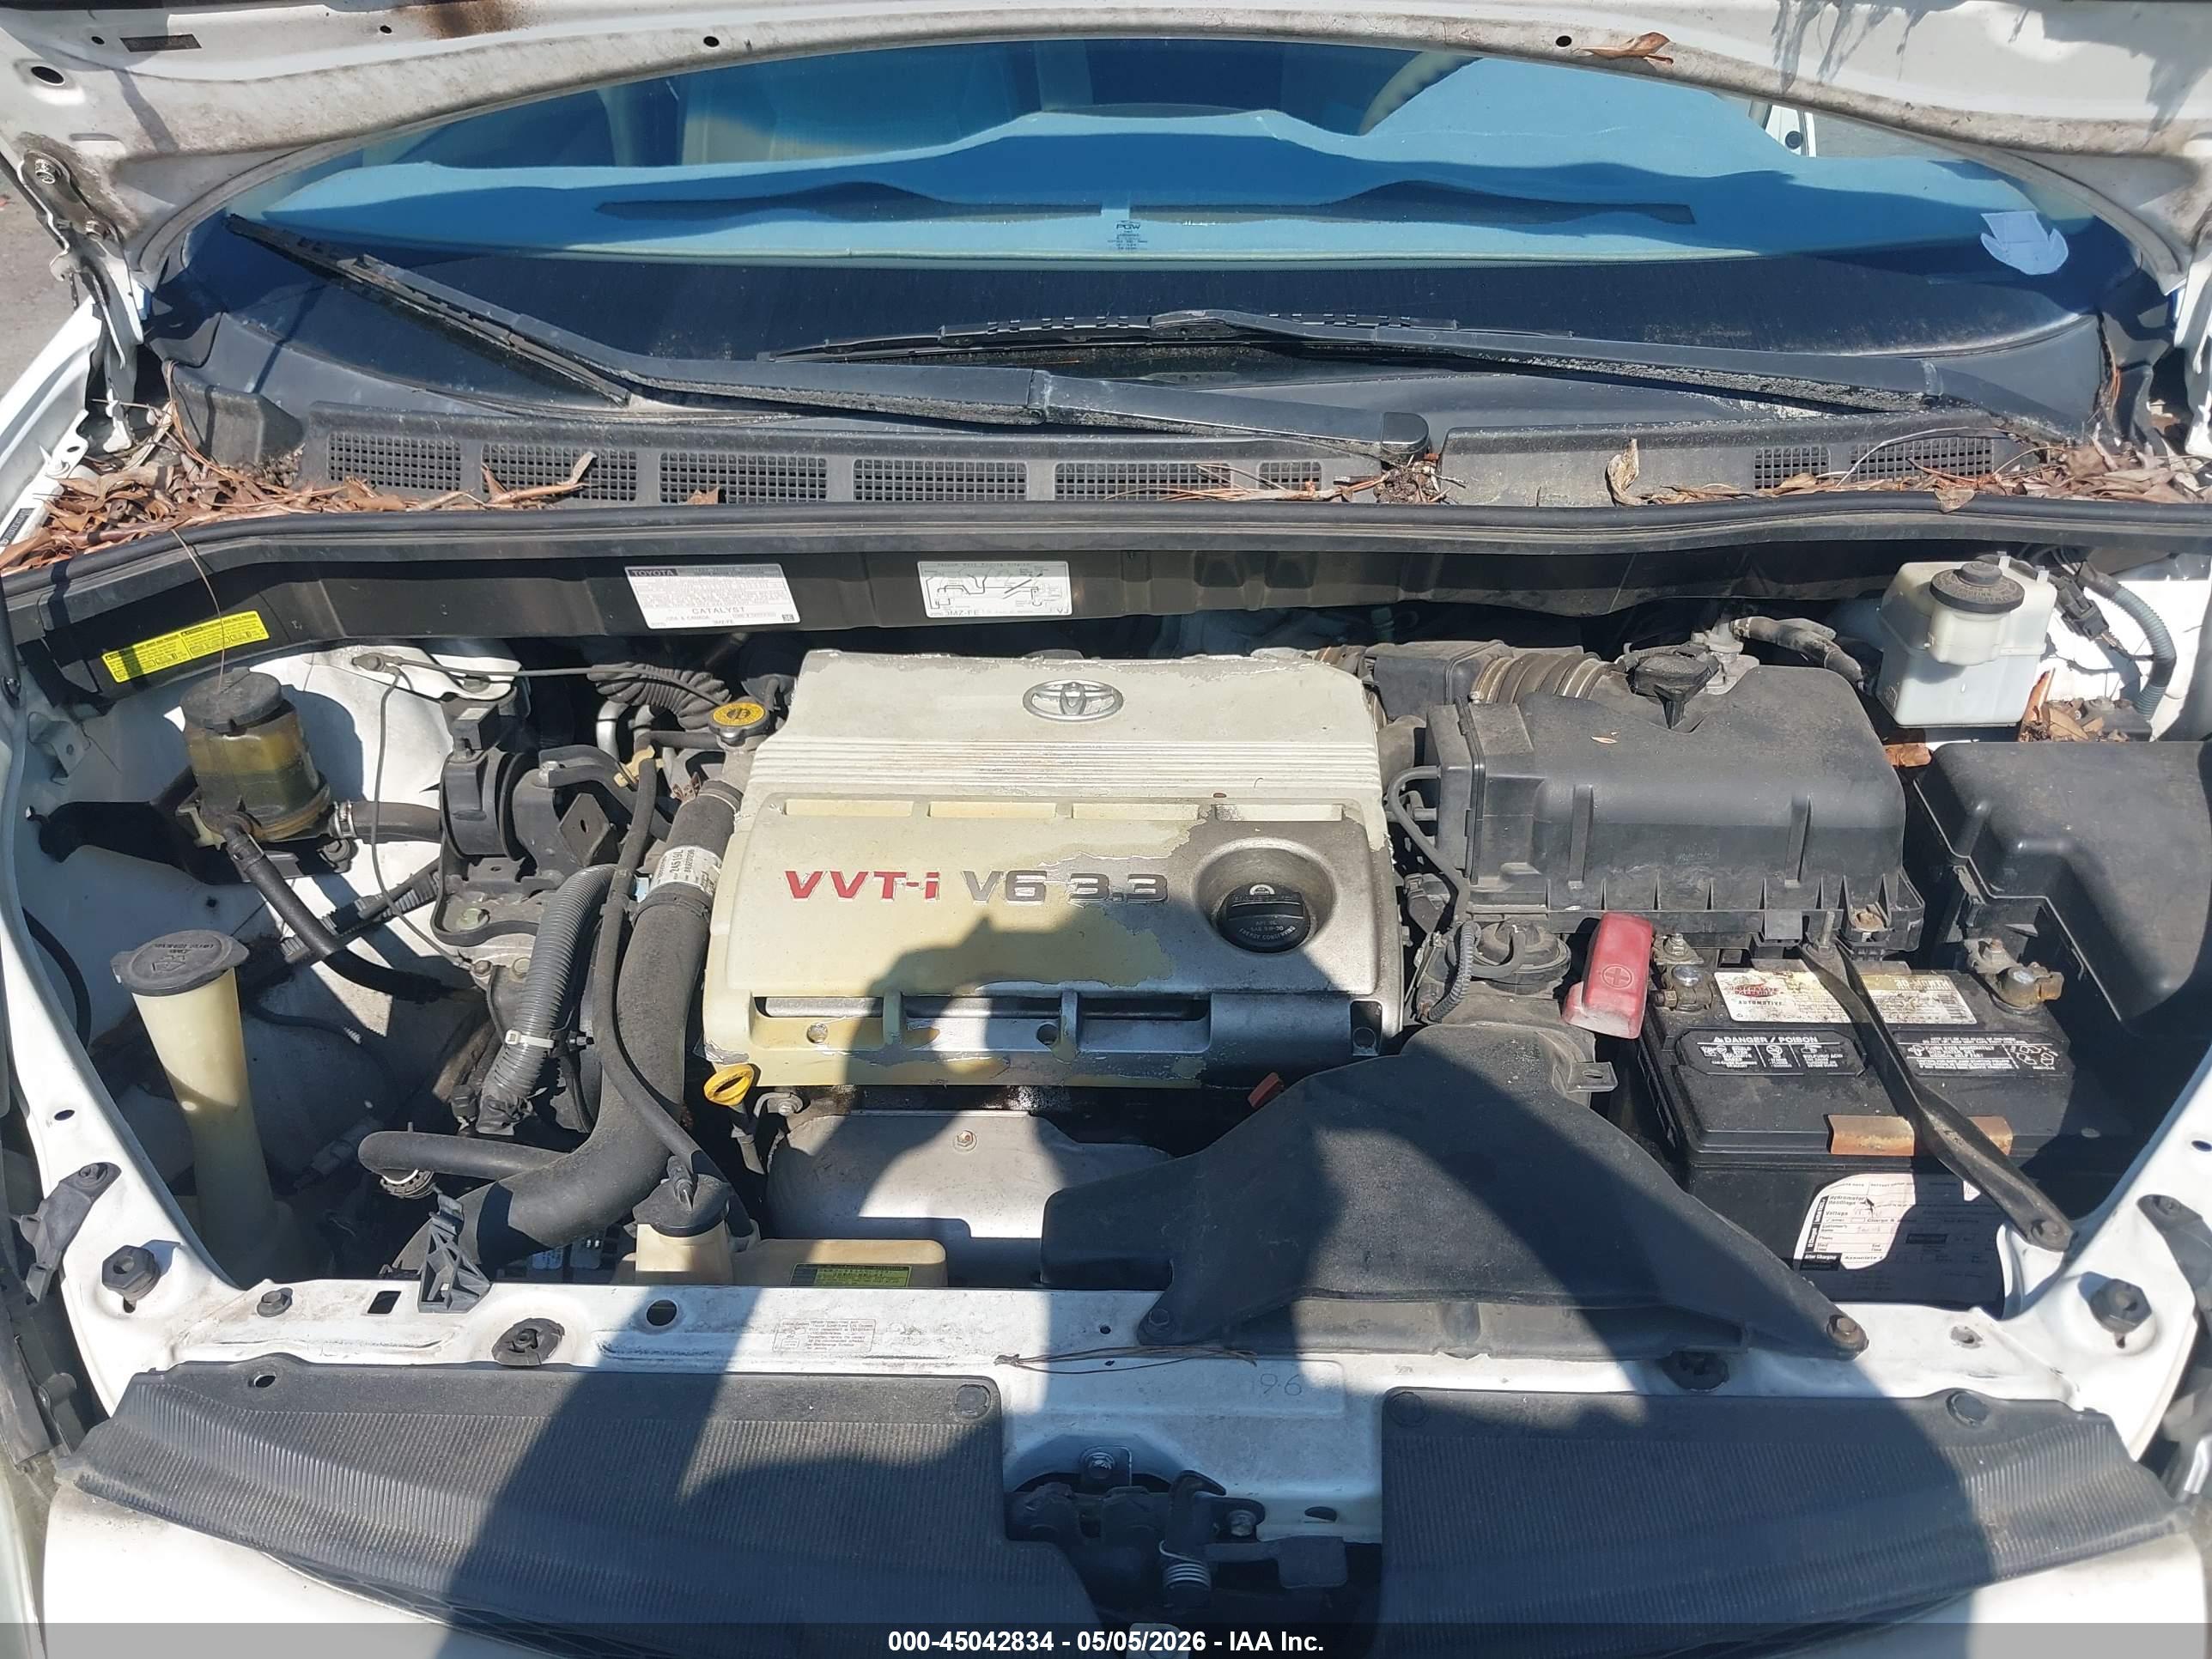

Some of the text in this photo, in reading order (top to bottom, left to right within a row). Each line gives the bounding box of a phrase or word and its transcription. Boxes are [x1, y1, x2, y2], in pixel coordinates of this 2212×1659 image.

[784, 870, 1170, 907] VVT-i V6 3.3
